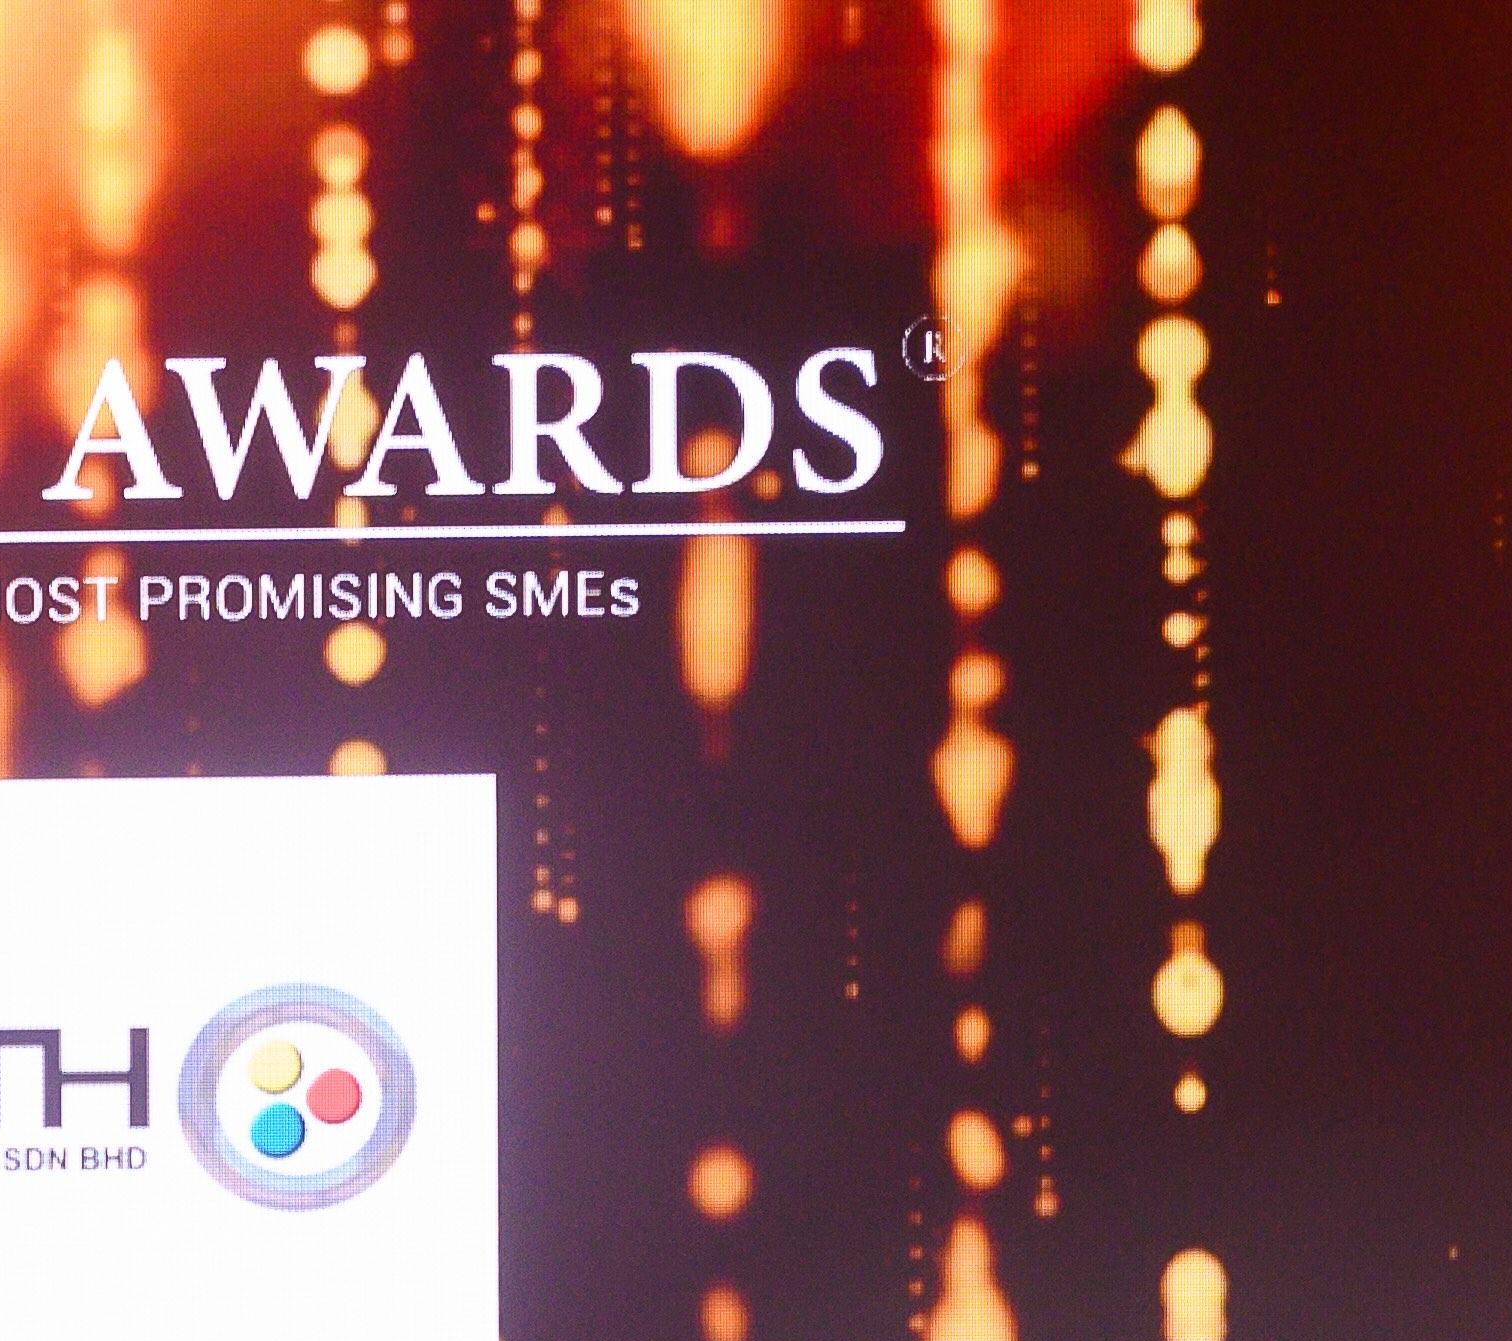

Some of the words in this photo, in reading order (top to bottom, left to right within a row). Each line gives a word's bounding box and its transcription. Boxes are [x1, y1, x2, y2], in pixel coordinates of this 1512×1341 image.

[40, 346, 885, 502] AWARDS
[138, 572, 463, 625] PROMISING
[484, 569, 640, 621] SMEs
[3, 1147, 68, 1172] SDN
[80, 1146, 148, 1171] BHD
